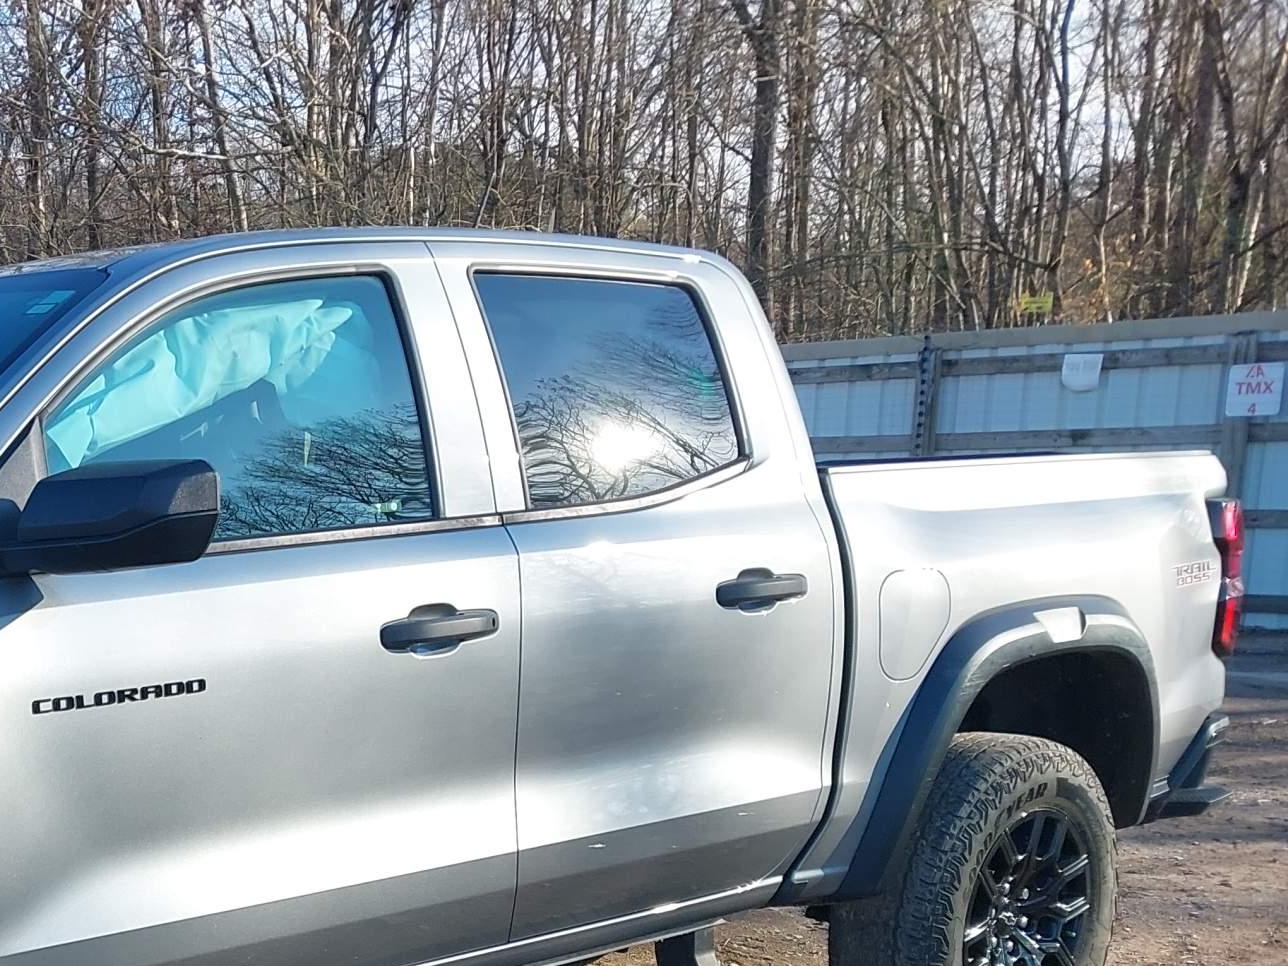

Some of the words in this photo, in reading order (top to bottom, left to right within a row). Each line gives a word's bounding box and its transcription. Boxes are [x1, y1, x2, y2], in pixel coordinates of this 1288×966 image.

[1235, 380, 1274, 396] TMX
[1171, 560, 1217, 577] TRAIL
[1176, 572, 1211, 586] BOSS
[31, 678, 207, 715] COLORADO
